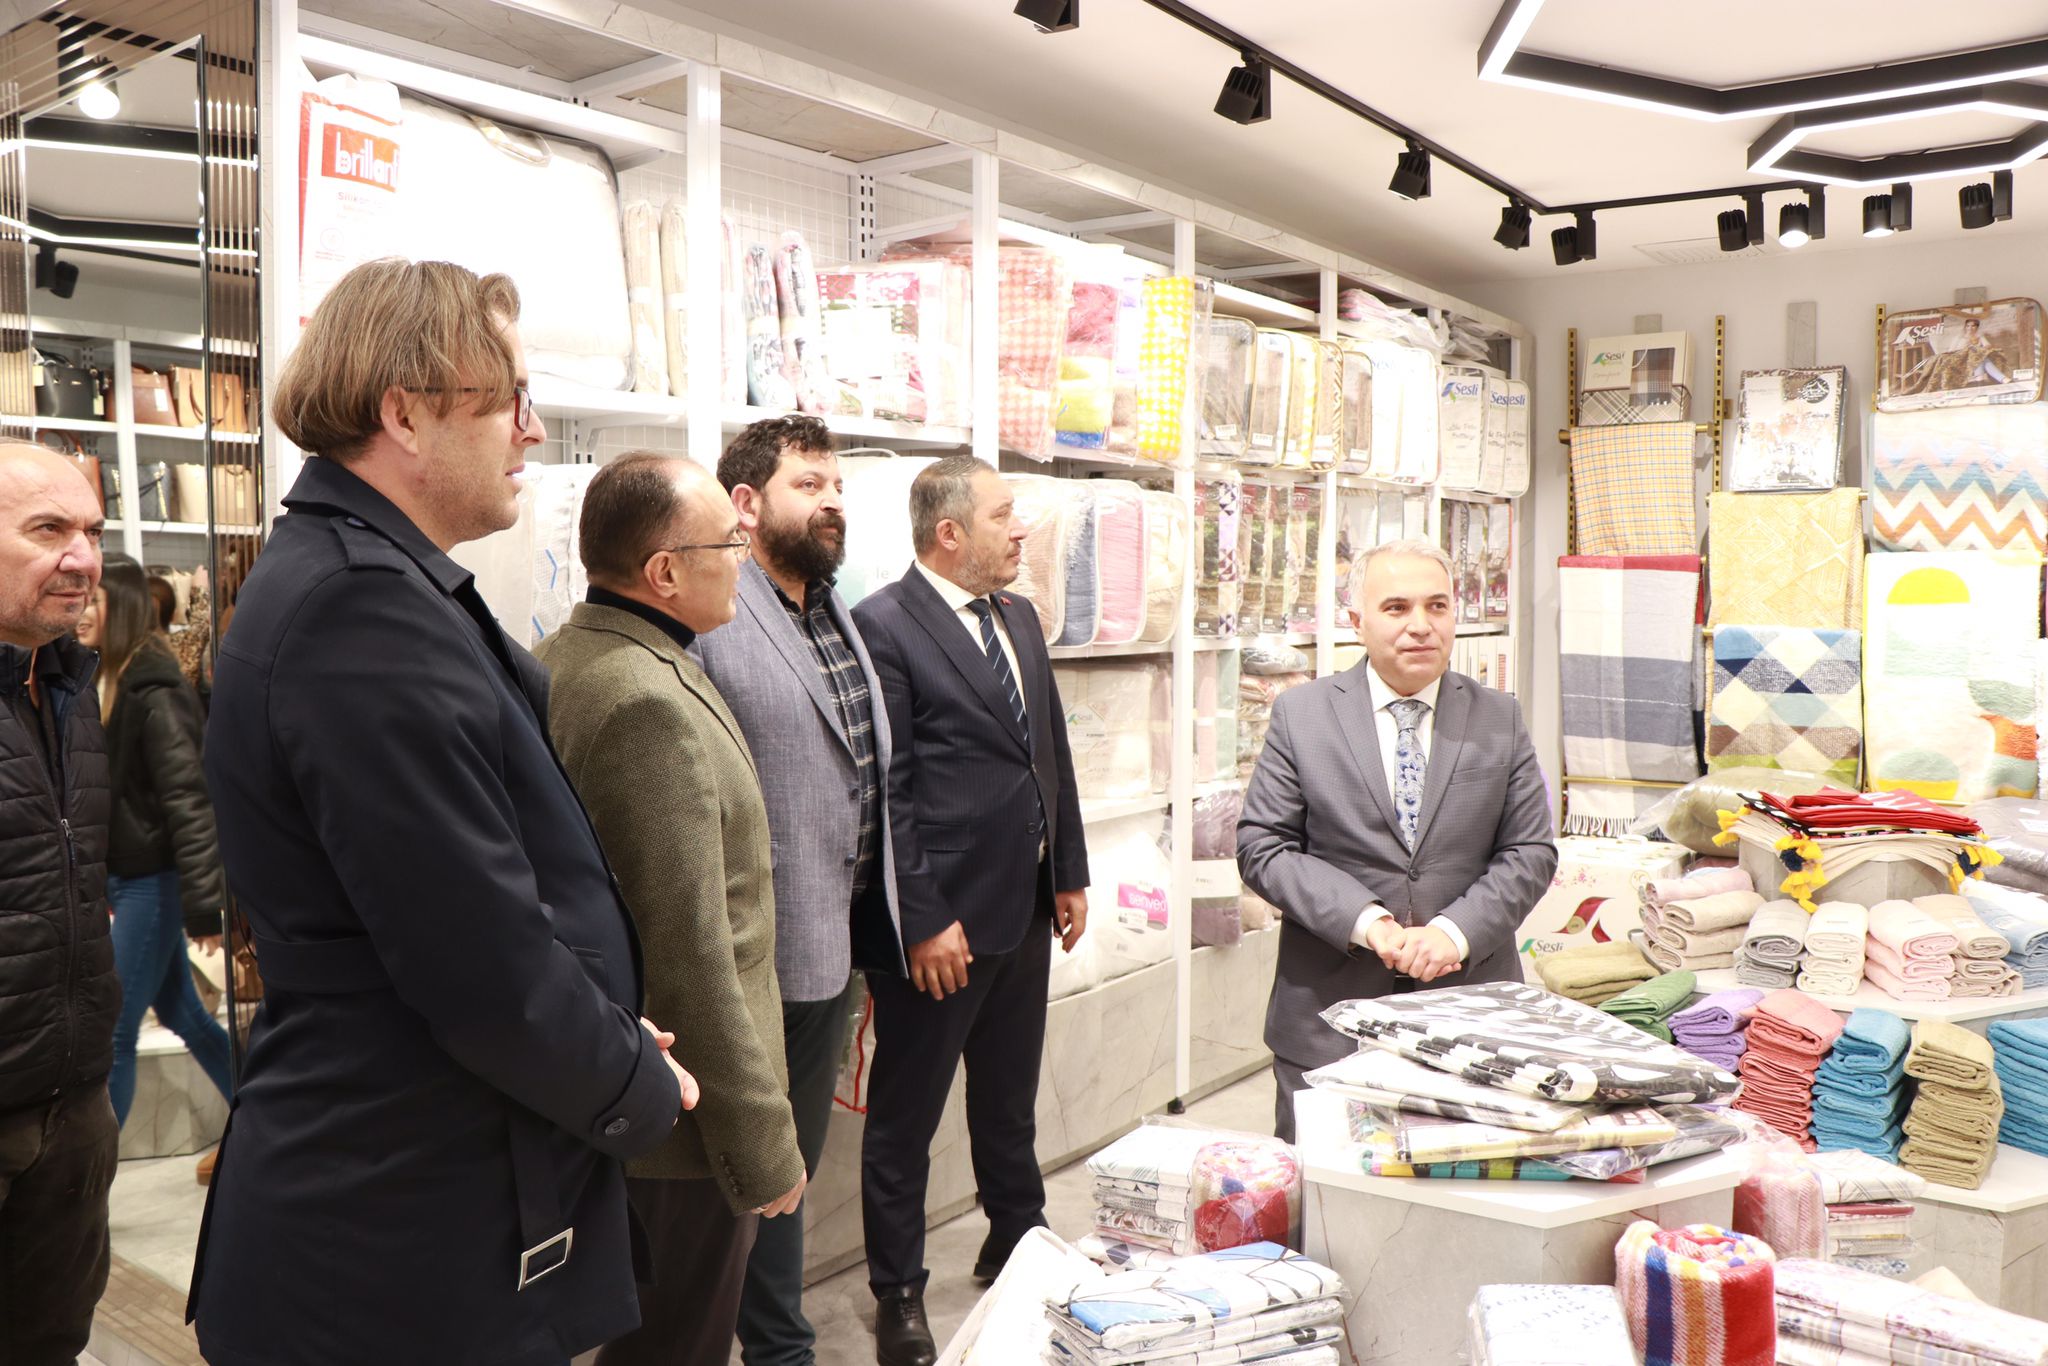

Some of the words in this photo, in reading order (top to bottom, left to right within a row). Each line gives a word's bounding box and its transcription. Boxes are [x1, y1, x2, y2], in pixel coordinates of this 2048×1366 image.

[1912, 323, 1945, 339] Sesli
[1454, 382, 1479, 397] Sesli
[1490, 390, 1508, 406] Ses
[1507, 392, 1526, 406] esli
[1535, 939, 1563, 954] Sesli
